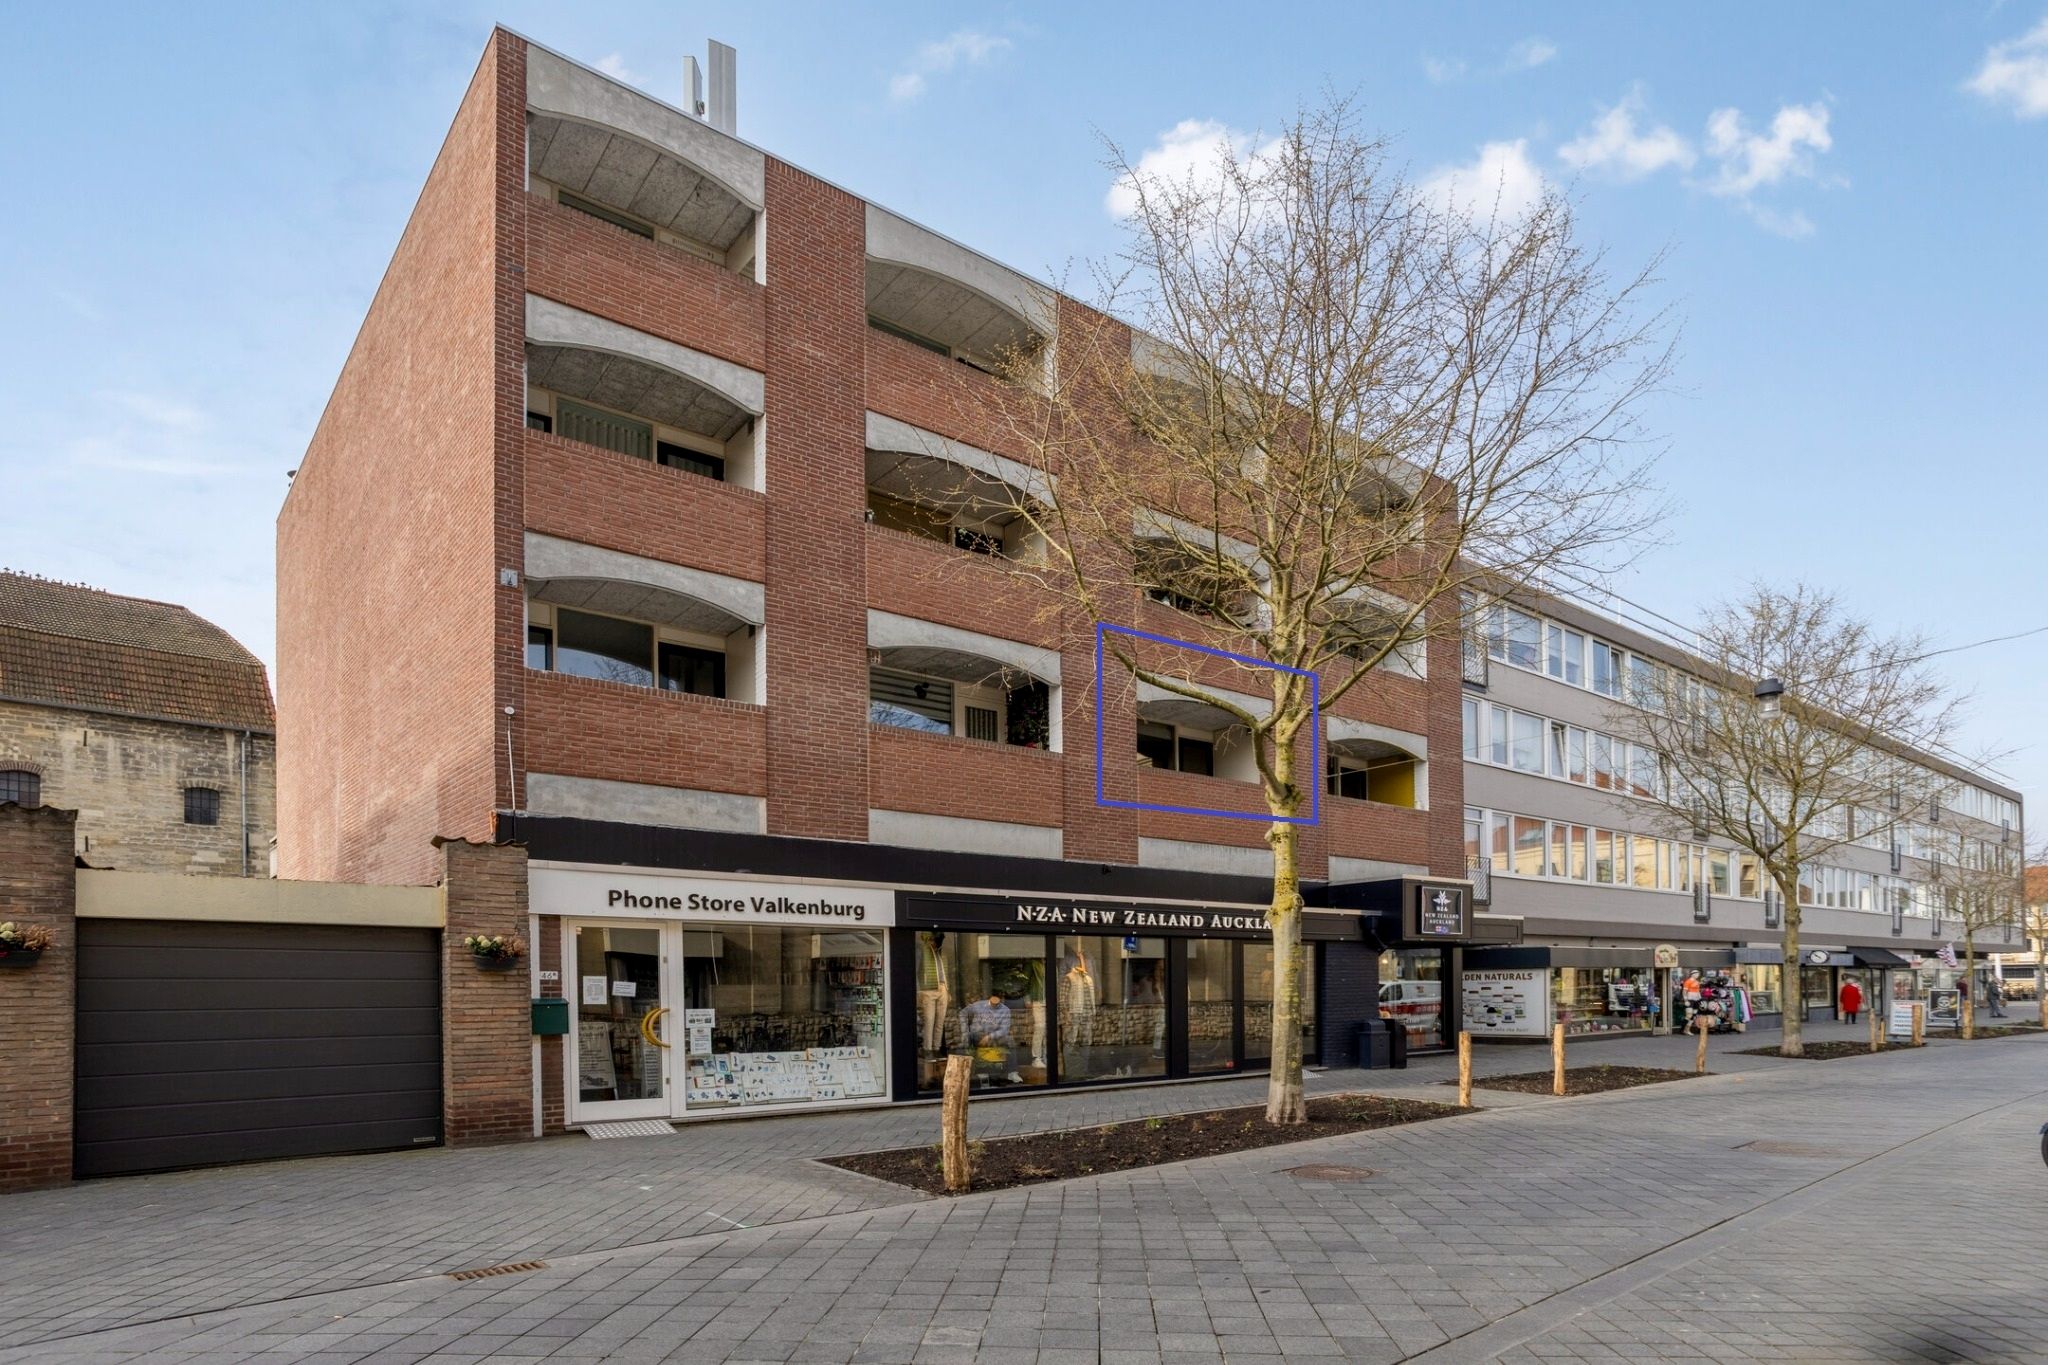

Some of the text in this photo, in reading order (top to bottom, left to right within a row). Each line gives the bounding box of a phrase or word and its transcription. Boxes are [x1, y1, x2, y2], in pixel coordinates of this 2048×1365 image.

[608, 889, 865, 921] Phone Store Valkenburg
[1072, 907, 1115, 924] NEW
[1124, 910, 1204, 927] ZEALAND
[1210, 914, 1273, 930] AUCKLA
[1462, 973, 1533, 981] DEN NATURALS
